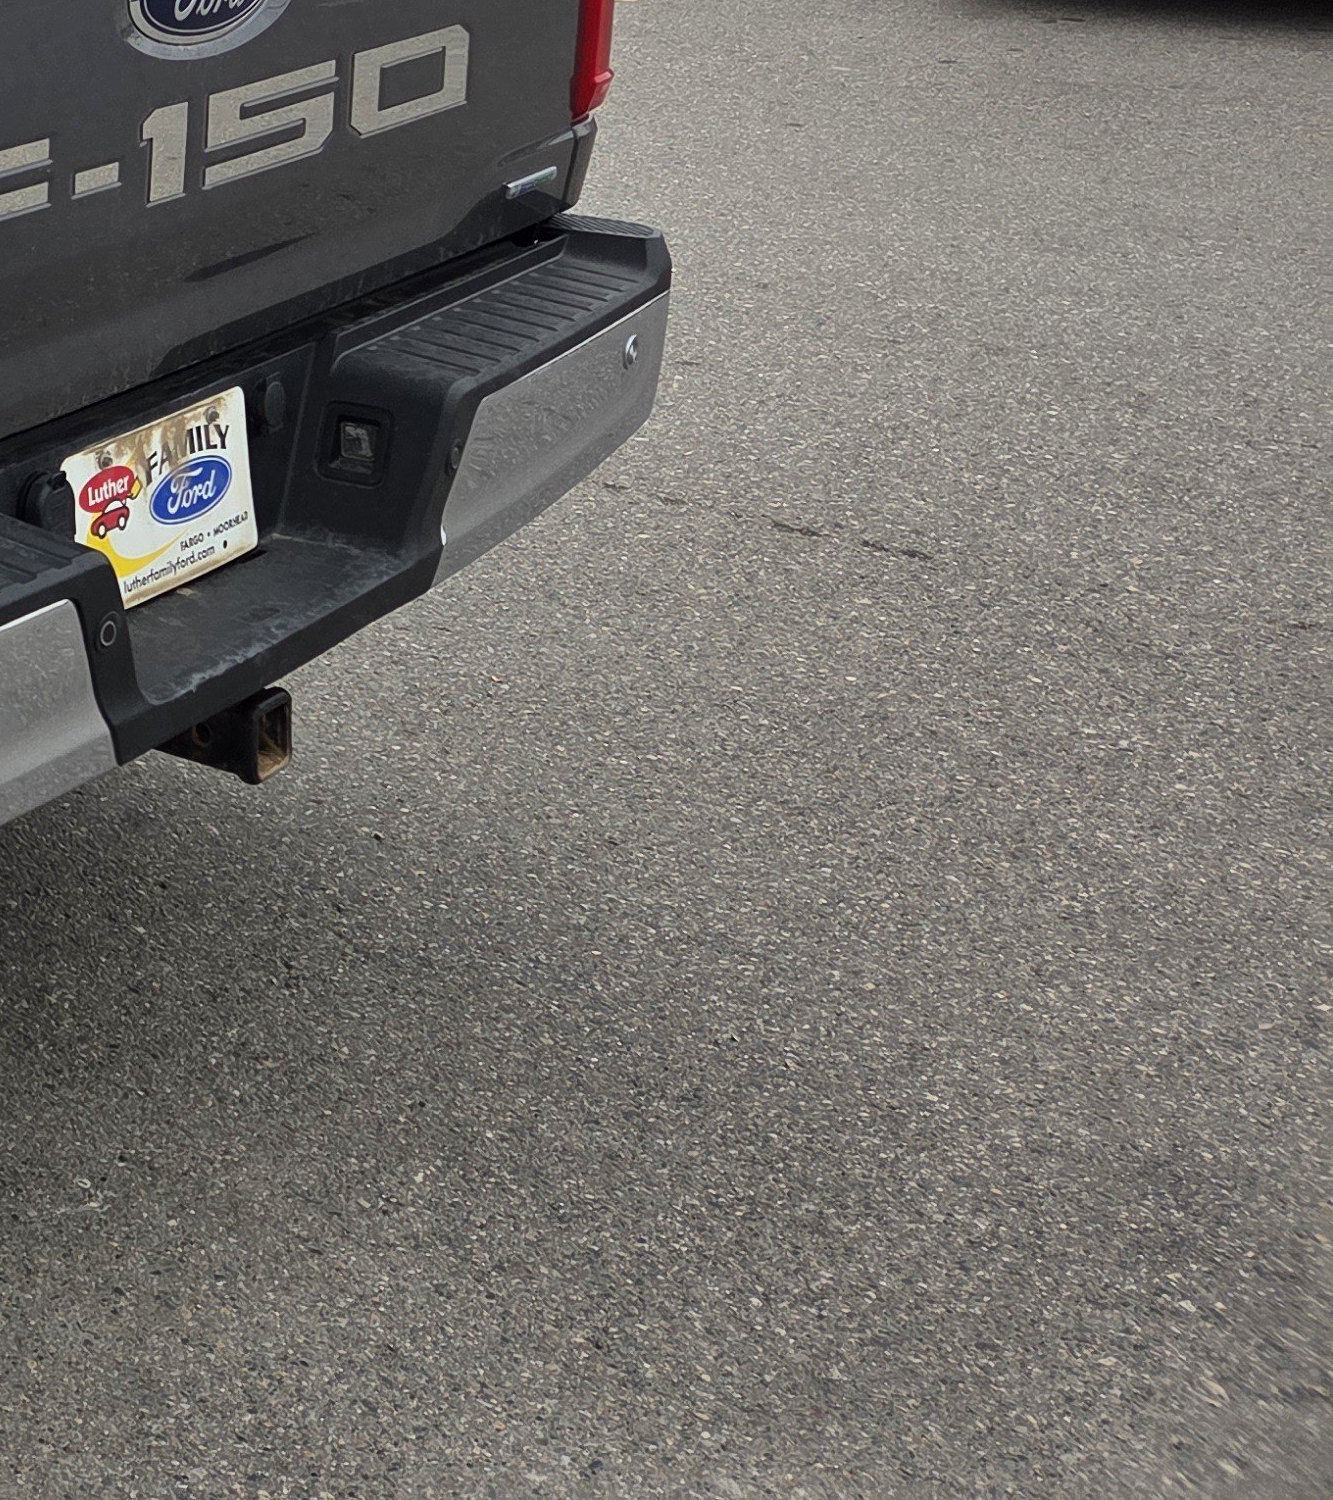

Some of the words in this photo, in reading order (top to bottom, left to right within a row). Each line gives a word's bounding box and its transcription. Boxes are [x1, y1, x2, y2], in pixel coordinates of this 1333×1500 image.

[143, 423, 230, 487] FAMILY
[87, 475, 130, 507] Luther
[167, 467, 218, 514] Ford
[179, 529, 205, 551] FARGO
[213, 510, 249, 537] MOORHEAD
[122, 545, 216, 595] lutherfamilyford.com
